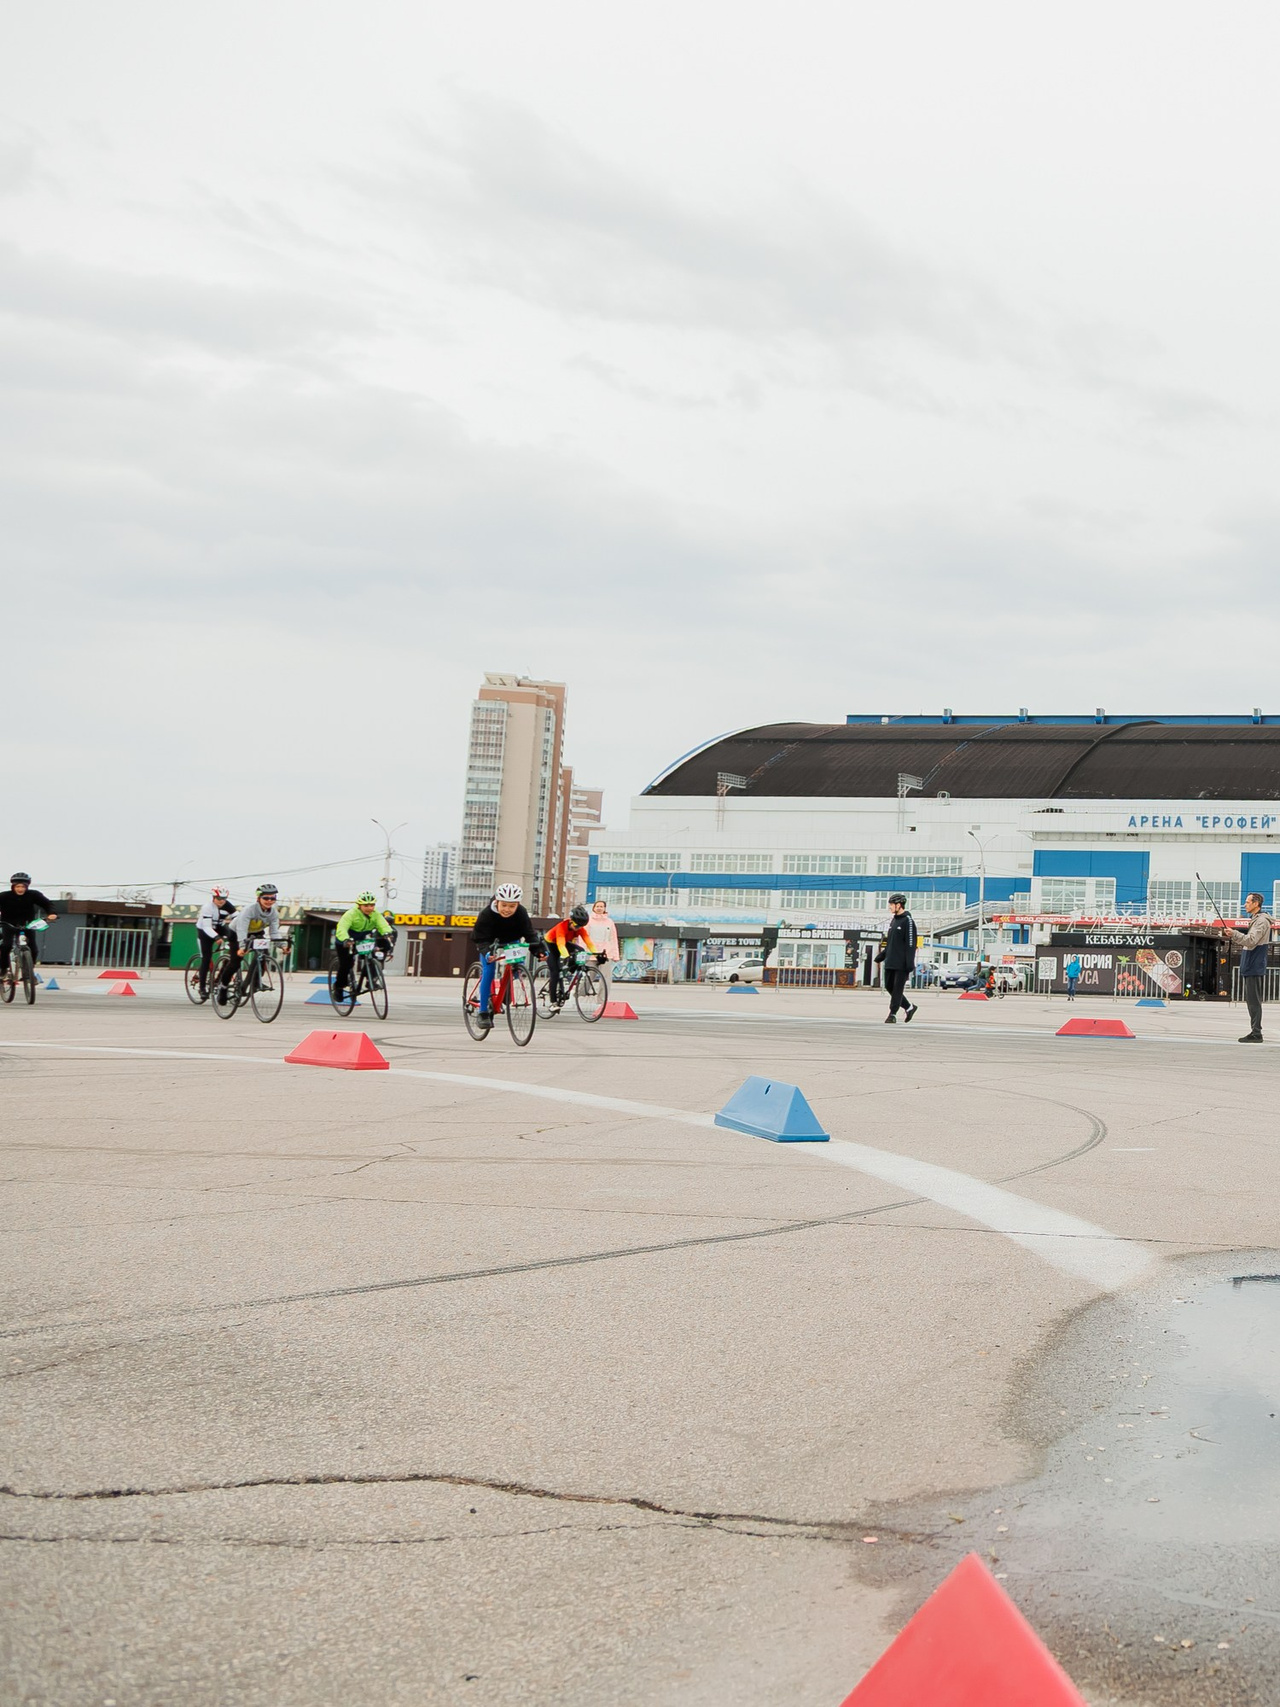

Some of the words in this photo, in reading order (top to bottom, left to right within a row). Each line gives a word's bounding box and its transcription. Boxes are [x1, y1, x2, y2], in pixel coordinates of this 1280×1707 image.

[1128, 815, 1183, 828] АРЕНА
[1196, 814, 1276, 829] "ЕРОФЕЙ"
[394, 914, 445, 926] DONER
[450, 915, 477, 927] KEB
[1234, 920, 1250, 928] ВХО
[706, 937, 737, 946] COFFEE
[738, 938, 762, 946] TOWN
[1085, 934, 1155, 946] КЕБАБ-ХАУС
[1062, 970, 1099, 985] ВУСА
